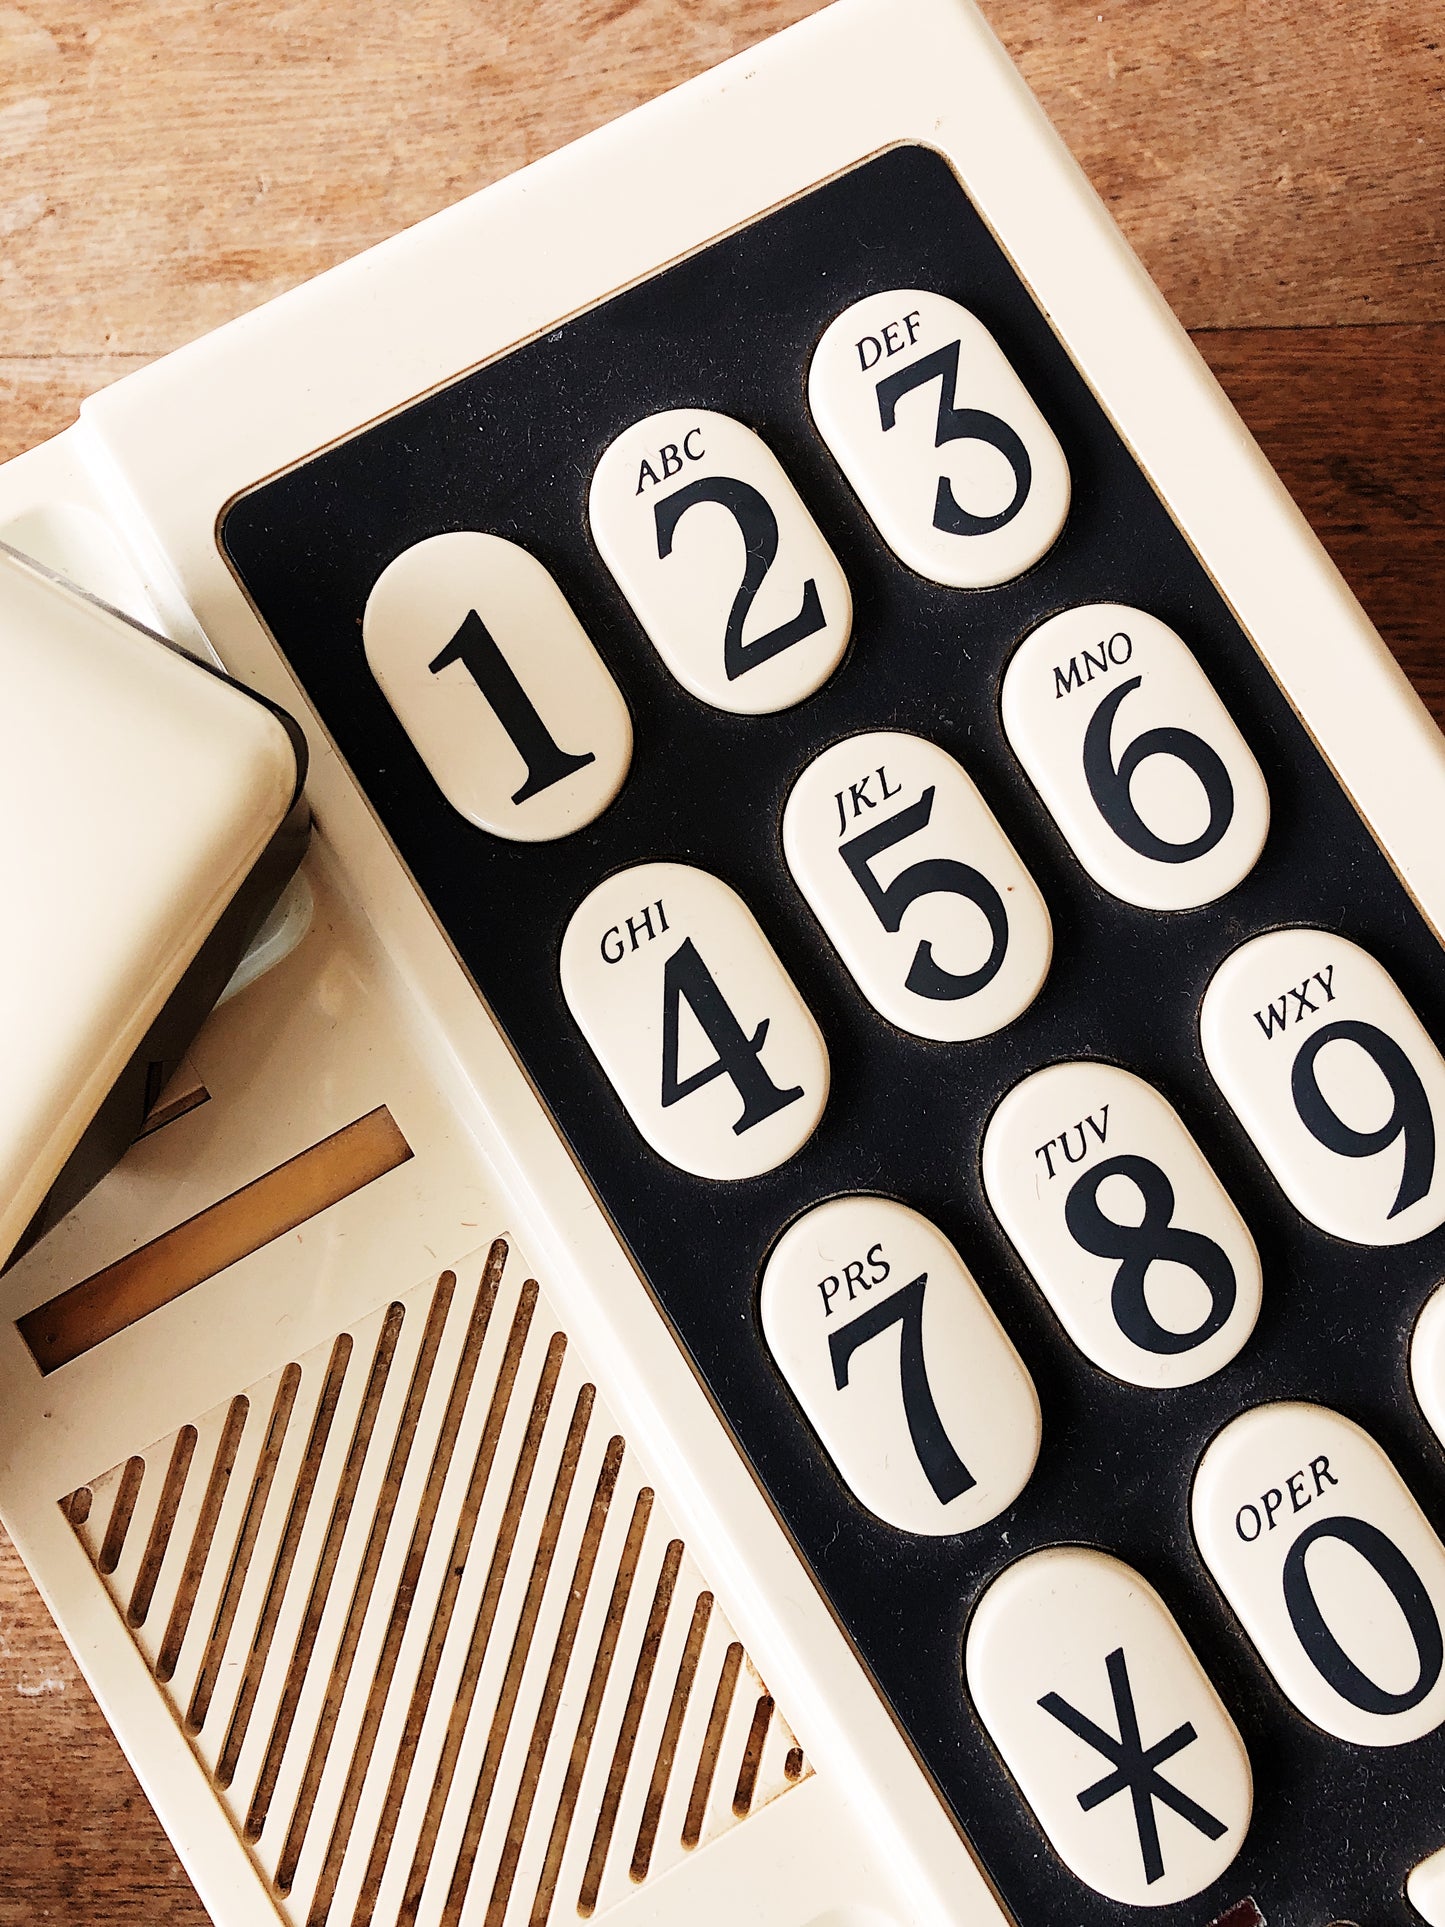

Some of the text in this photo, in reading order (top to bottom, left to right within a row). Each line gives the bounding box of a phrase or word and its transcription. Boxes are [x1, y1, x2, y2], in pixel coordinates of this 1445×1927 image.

[854, 310, 921, 372] DEF
[635, 427, 707, 497] ABC
[875, 338, 1032, 537] 3
[653, 476, 828, 682] 2
[1052, 632, 1133, 699] MNO
[427, 608, 596, 806] 1
[834, 765, 902, 837] JKL
[1082, 675, 1235, 865] 6
[600, 899, 671, 965] GHI
[838, 785, 1009, 1001] 5
[661, 936, 805, 1137] 4
[1253, 964, 1336, 1041] WXY
[1034, 1104, 1110, 1181] TUV
[1290, 1019, 1436, 1220] 9
[817, 1243, 892, 1318] PRS
[1064, 1154, 1237, 1356] 8
[827, 1272, 978, 1506] 7
[1235, 1455, 1339, 1542] OPER
[1282, 1515, 1444, 1716] 0
